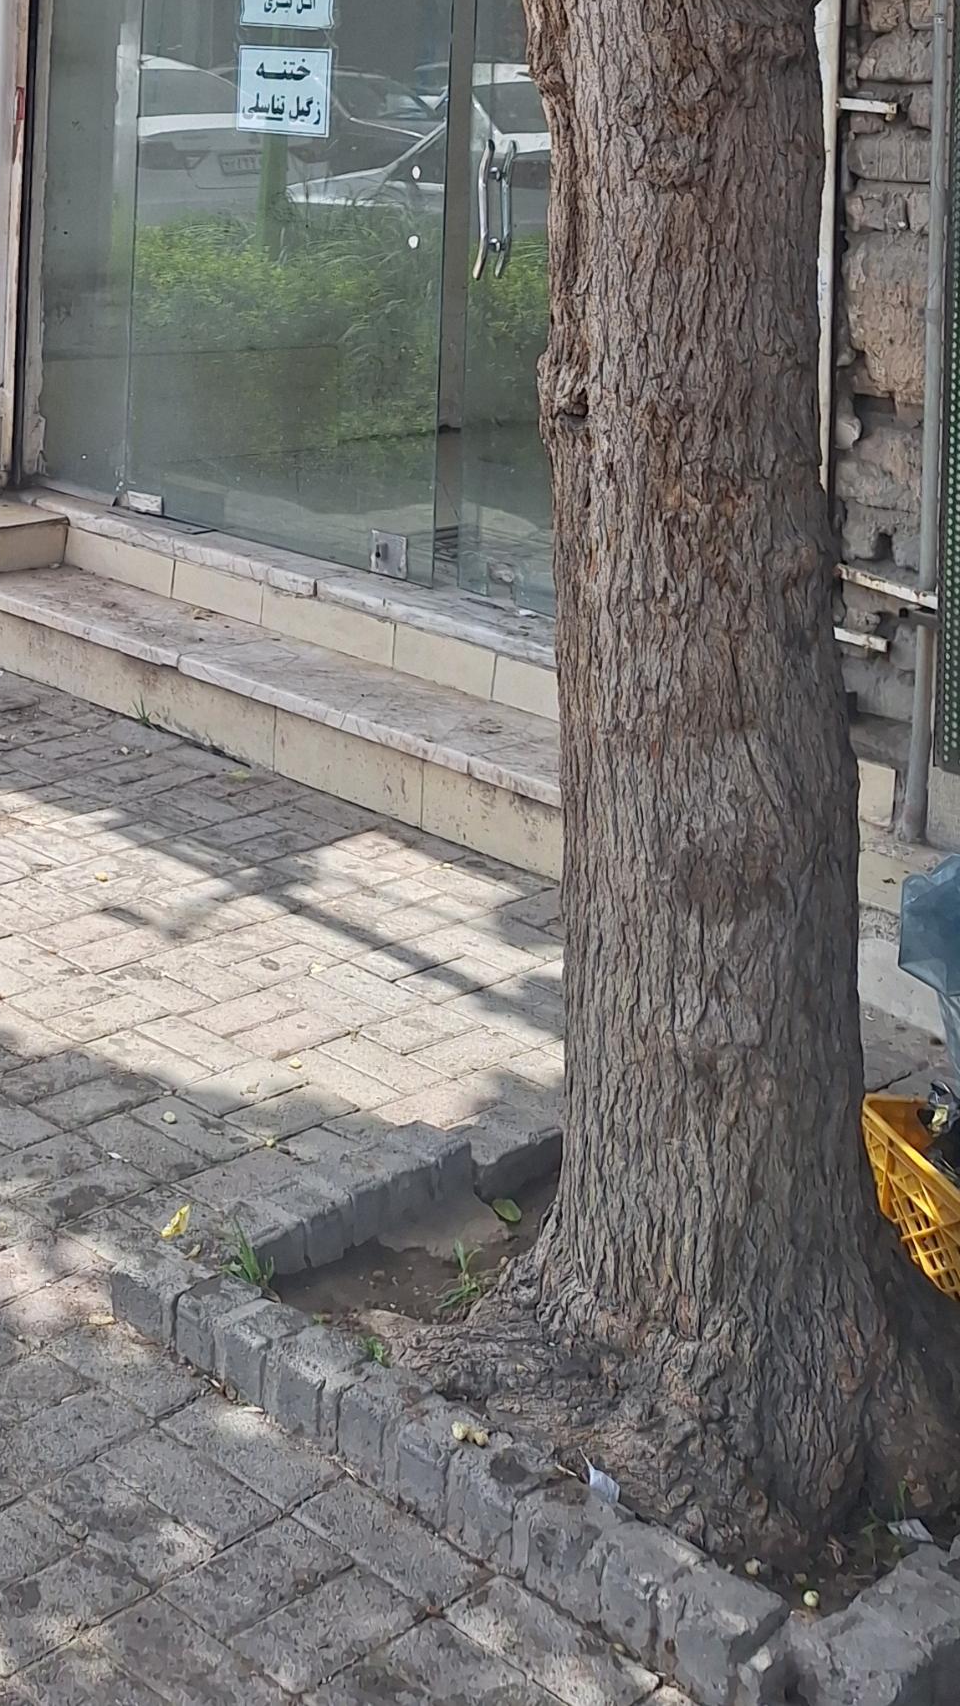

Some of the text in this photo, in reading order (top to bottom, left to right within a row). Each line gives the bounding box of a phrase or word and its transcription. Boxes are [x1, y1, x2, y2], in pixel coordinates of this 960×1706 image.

[256, 58, 311, 81] ختنه
[242, 93, 321, 125] زگیل تناسلی
